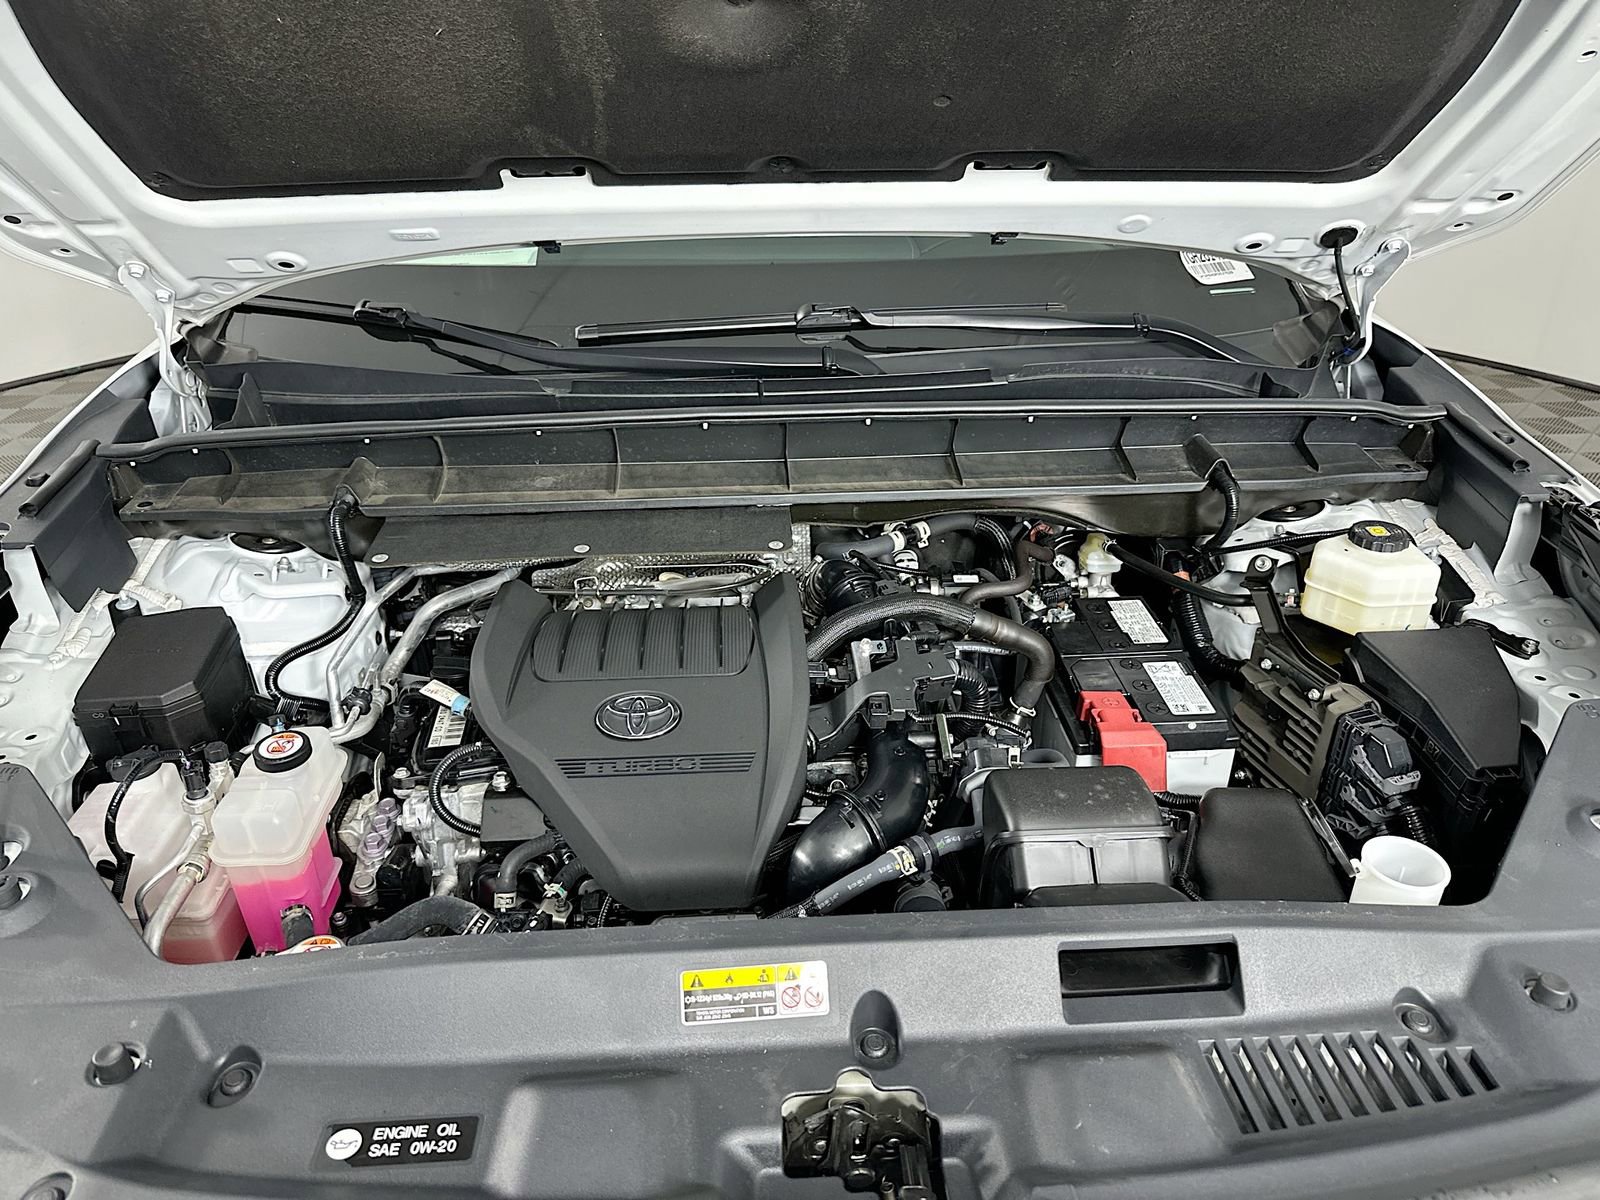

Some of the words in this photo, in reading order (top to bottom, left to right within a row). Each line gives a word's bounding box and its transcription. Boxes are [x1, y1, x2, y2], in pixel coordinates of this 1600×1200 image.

[588, 757, 697, 773] TURBO
[372, 1124, 429, 1141] ENGINE
[436, 1123, 461, 1137] OIL
[368, 1142, 401, 1158] SAE
[409, 1139, 457, 1155] 0W-20
